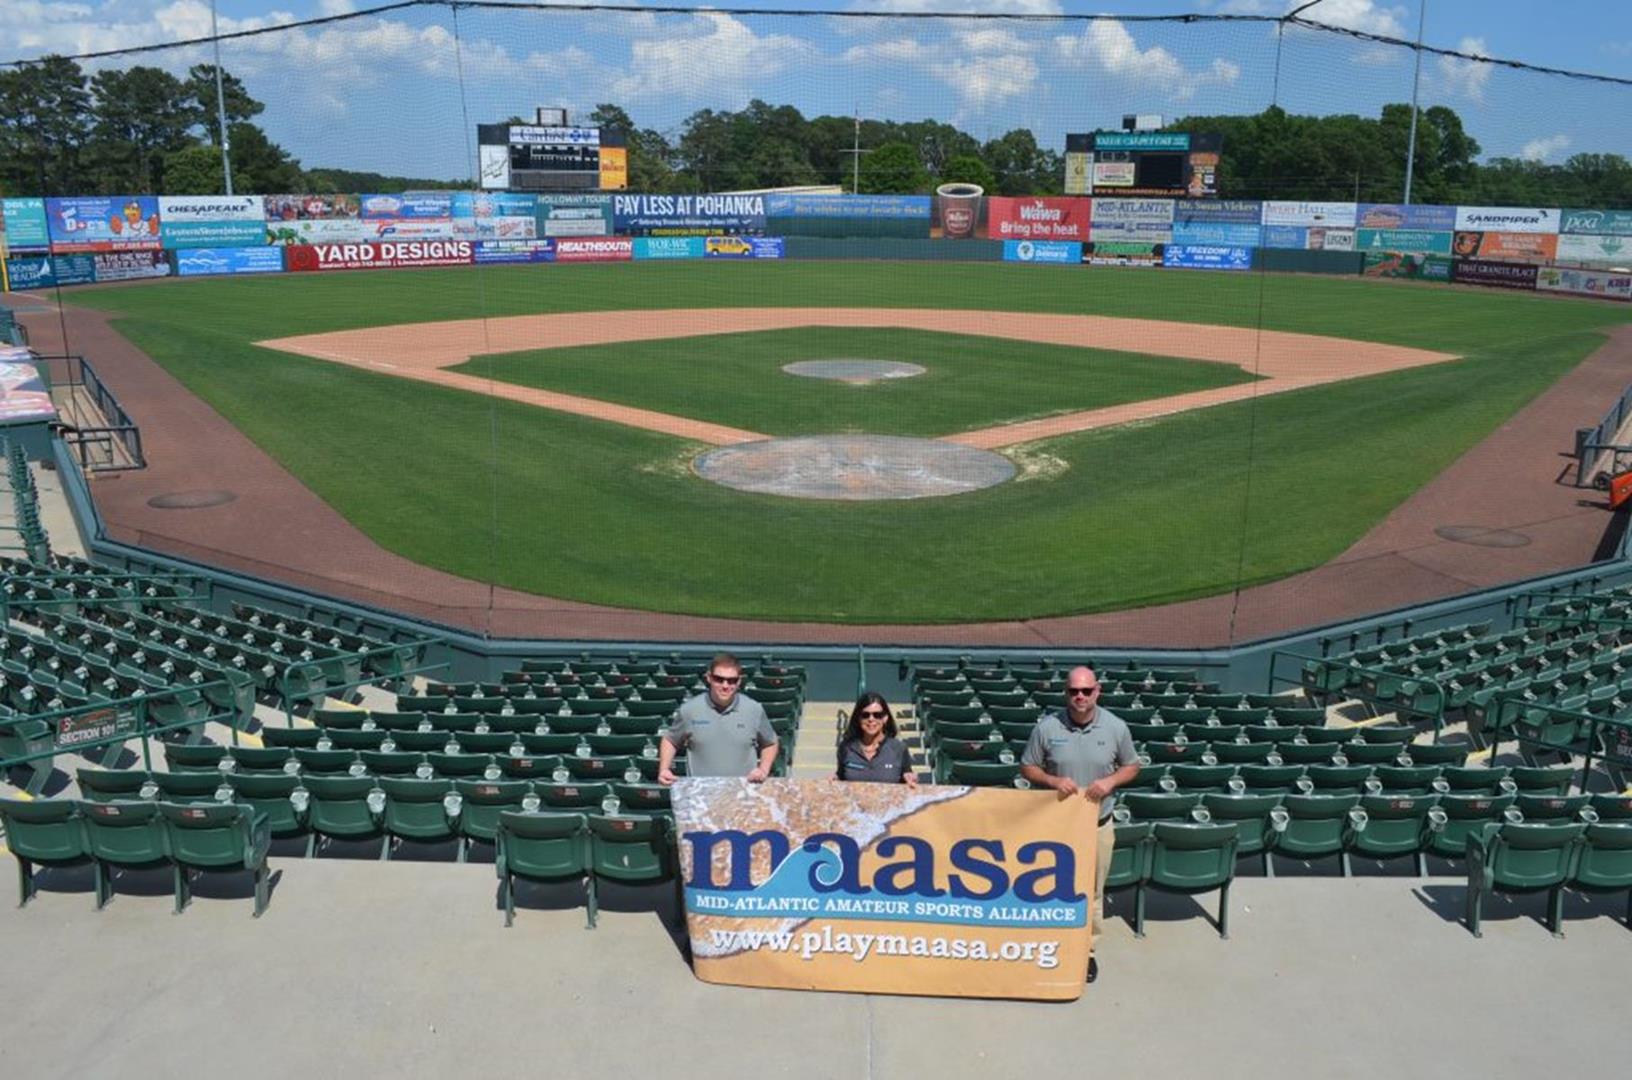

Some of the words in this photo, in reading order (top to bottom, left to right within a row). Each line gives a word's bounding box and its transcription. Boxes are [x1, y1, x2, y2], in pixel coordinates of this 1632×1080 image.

[537, 195, 583, 204] HOLLOWAY
[585, 195, 611, 204] TOURS
[615, 196, 640, 215] PAY
[644, 196, 674, 215] LESS
[677, 196, 692, 215] AT
[696, 196, 764, 215] POHANKA
[1179, 201, 1191, 209] Dr.
[1195, 201, 1223, 210] Susan
[1225, 201, 1258, 211] Vickers
[167, 204, 248, 214] CHESAPEAKE
[1020, 205, 1061, 220] Wawa
[1096, 202, 1172, 213] MID-ATLANTIC
[1466, 214, 1540, 224] SANDPIPER
[1000, 222, 1030, 235] Bring
[1032, 222, 1051, 233] the
[314, 244, 374, 262] YARD
[382, 242, 471, 260] DESIGNS
[557, 241, 633, 252] HEALTHSOUTH
[1458, 264, 1478, 273] THAT
[1479, 265, 1512, 276] GRANITE
[1513, 267, 1537, 277] PLACE
[60, 727, 100, 744] SECTION
[101, 725, 115, 736] 101
[683, 829, 1087, 903] maasa
[696, 895, 820, 912] MID-ATLANTIC
[825, 898, 910, 914] AMATEUR
[914, 902, 983, 919] SPORTS
[988, 906, 1077, 921] ALLIANCE
[710, 925, 1060, 967] www.playmaasa.org
